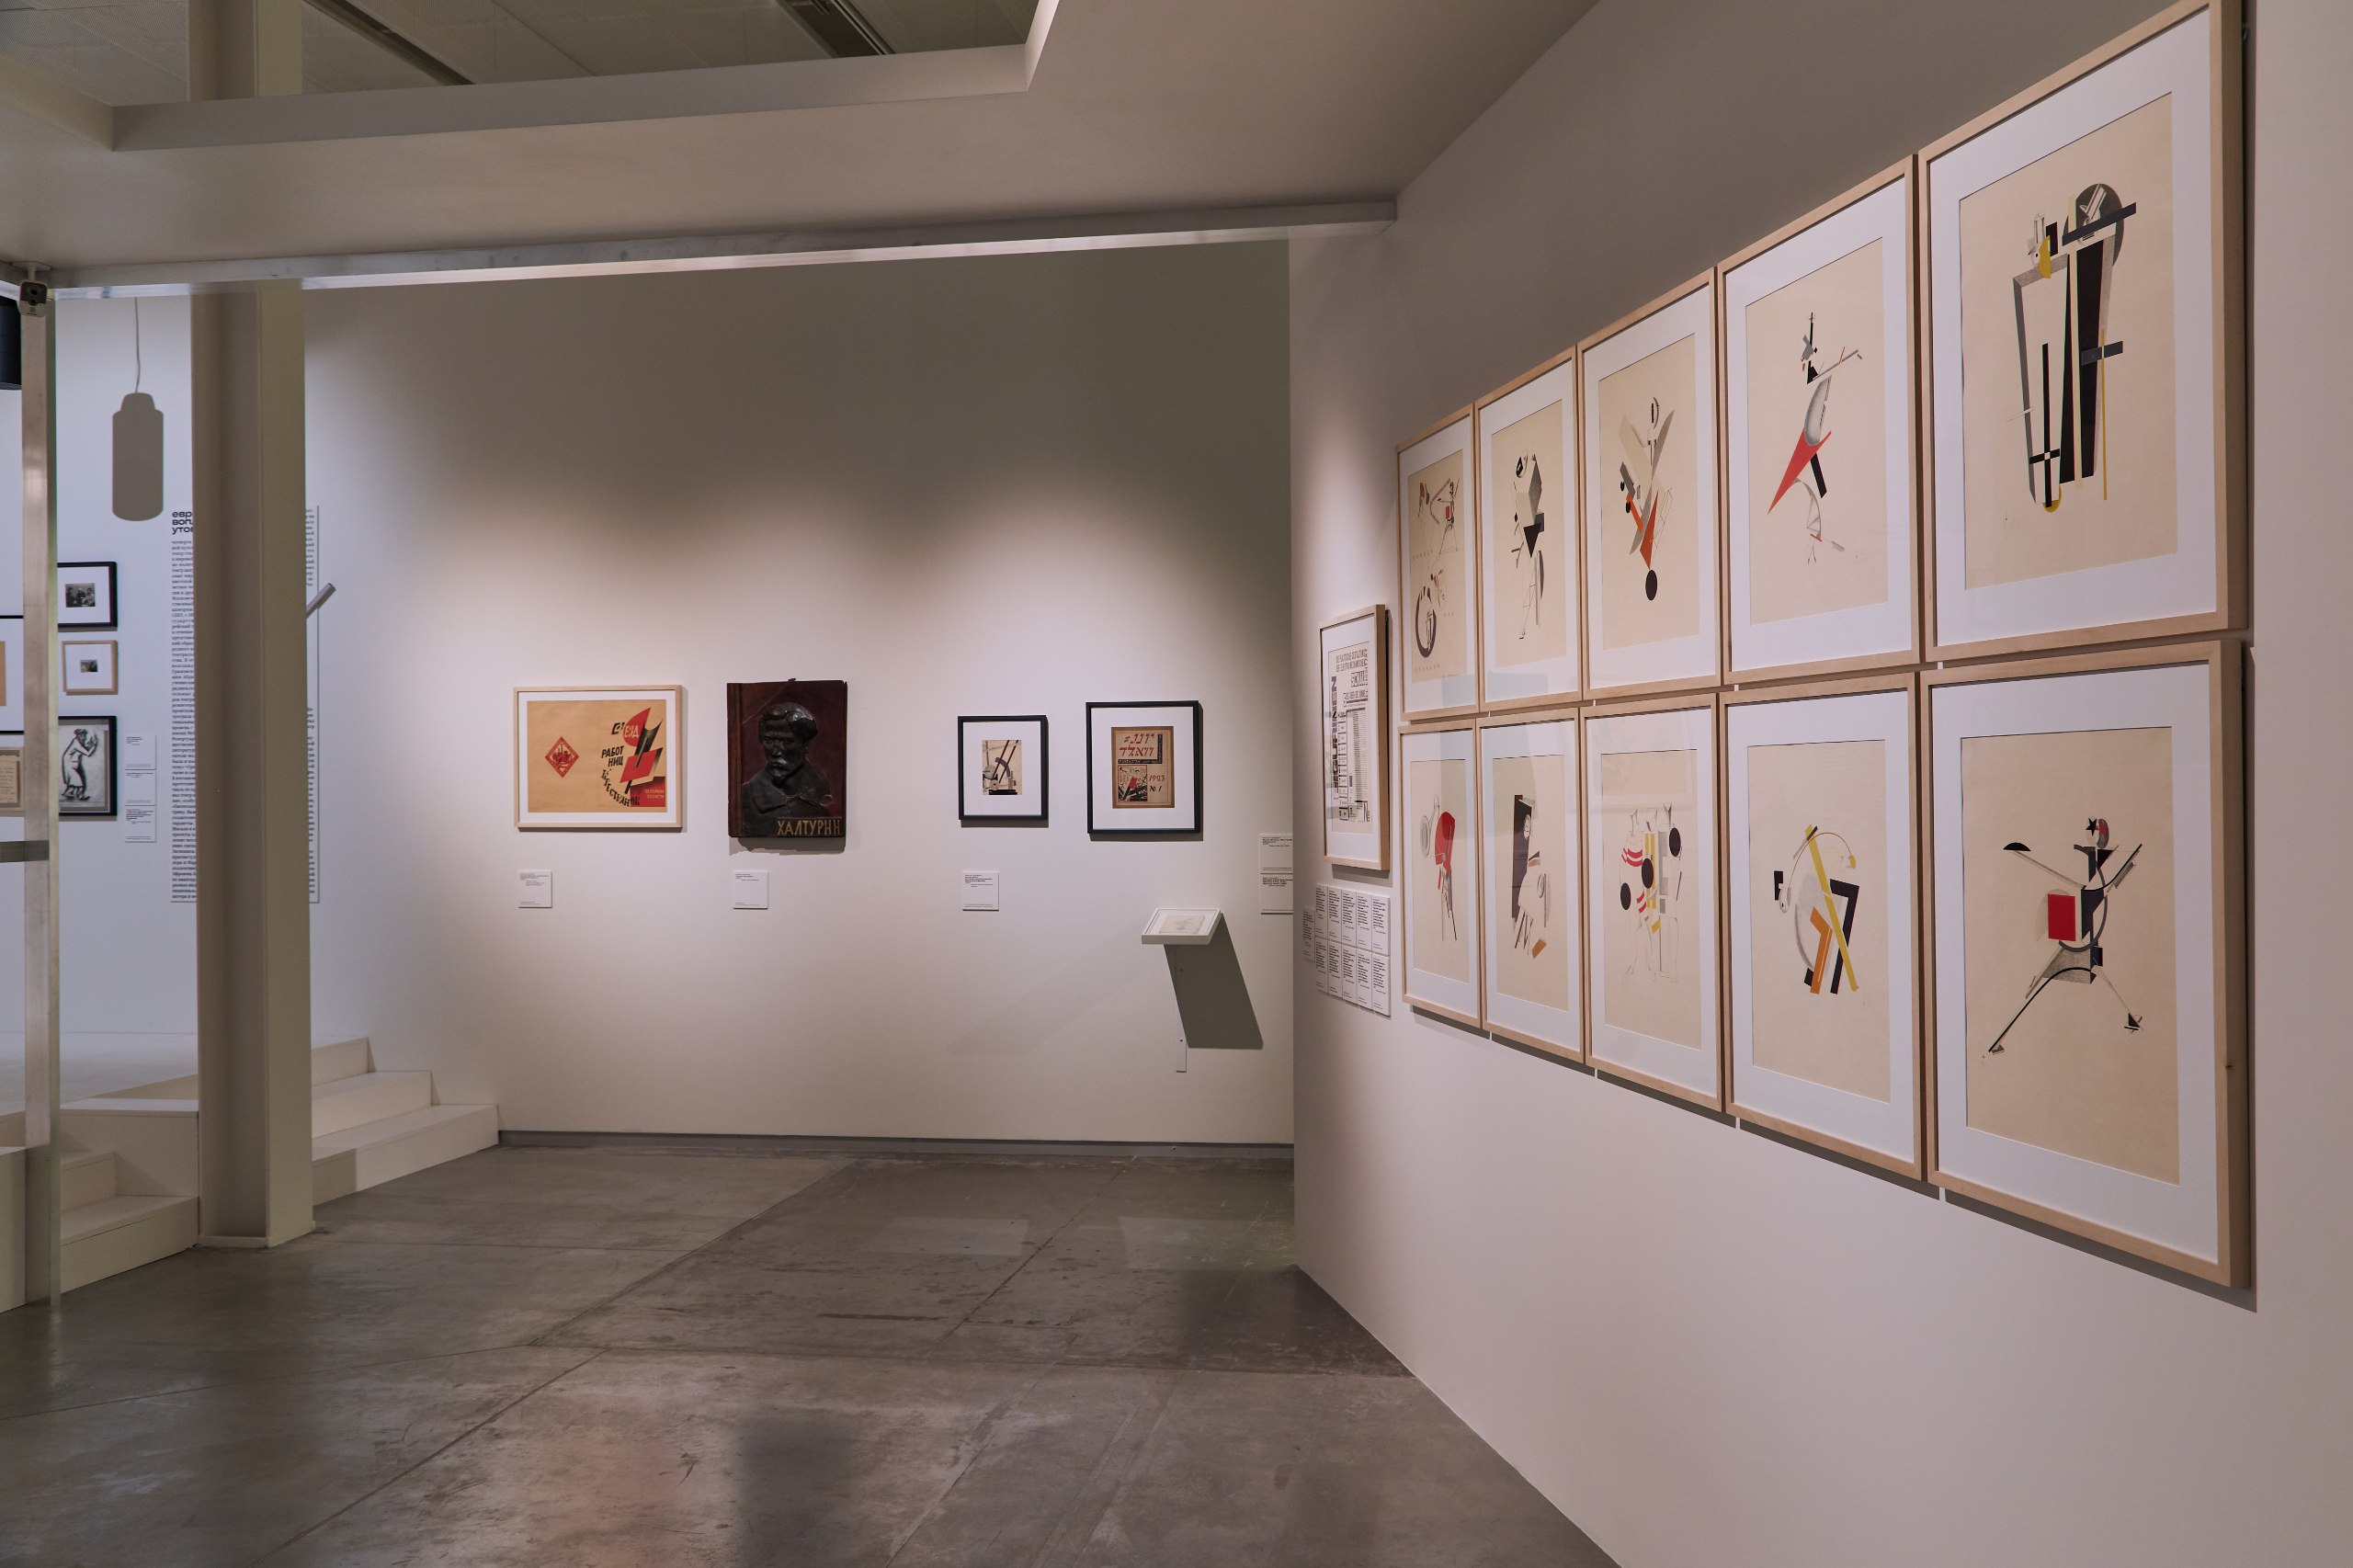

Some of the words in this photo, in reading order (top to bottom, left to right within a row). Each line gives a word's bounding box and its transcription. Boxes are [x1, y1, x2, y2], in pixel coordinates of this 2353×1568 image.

[172, 511, 192, 519] евр
[601, 745, 624, 758] РАБОТ
[608, 756, 624, 767] НИЦ
[777, 819, 841, 836] ХАЛТУРИН
